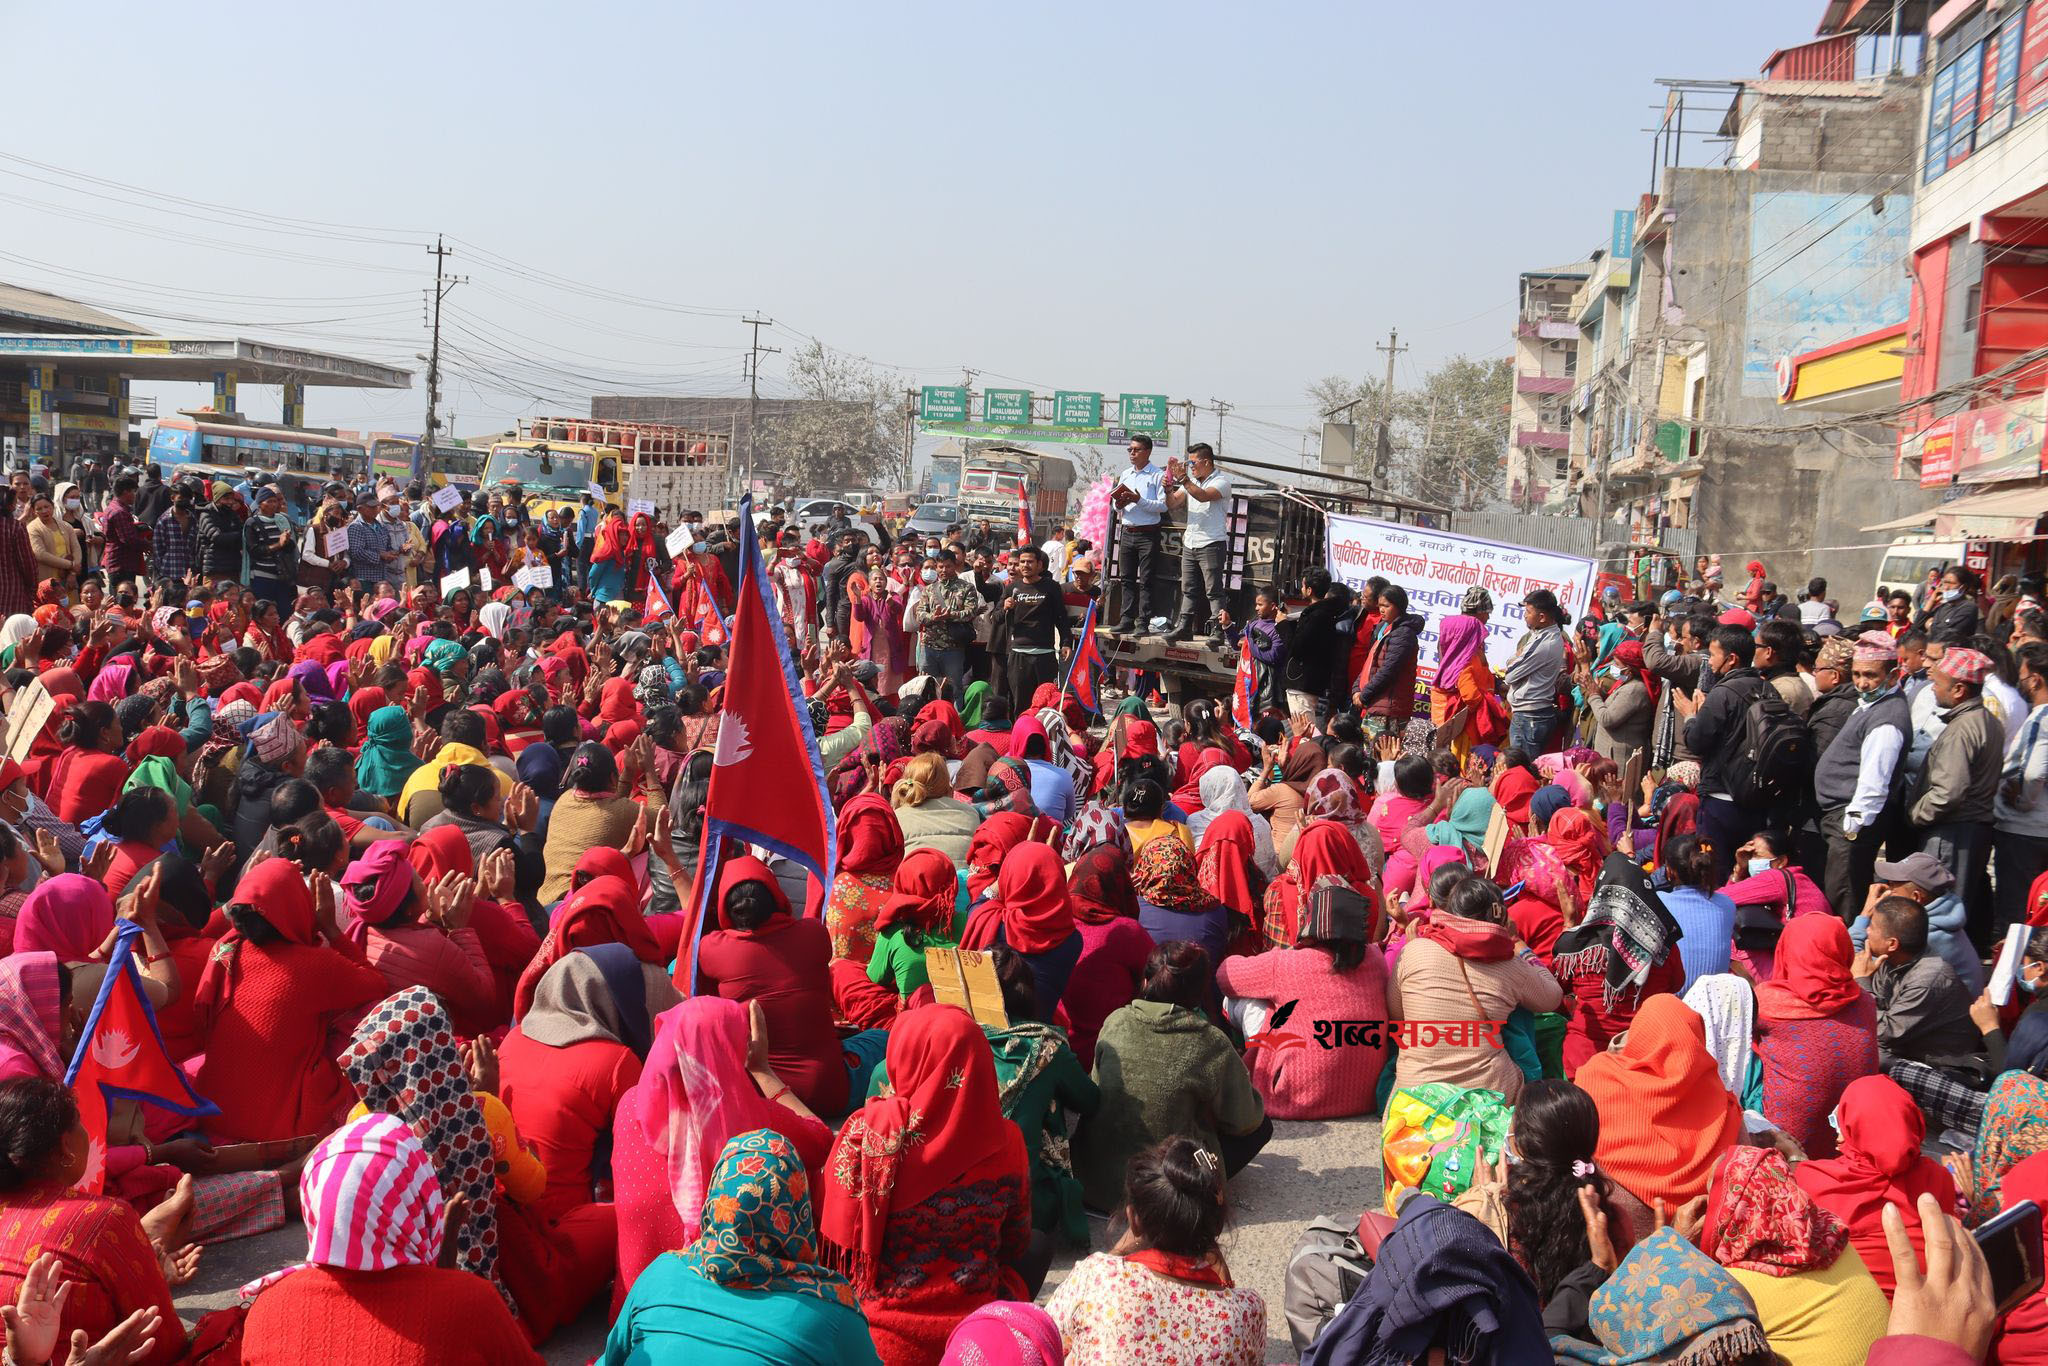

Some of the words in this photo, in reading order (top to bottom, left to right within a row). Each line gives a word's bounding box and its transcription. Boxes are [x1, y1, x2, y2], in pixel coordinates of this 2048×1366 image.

[1064, 410, 1090, 418] ATTARIYA
[1128, 413, 1157, 421] SURKHET
[454, 475, 479, 483] SUNSTA
[1247, 536, 1275, 563] RS
[1460, 547, 1469, 556] र
